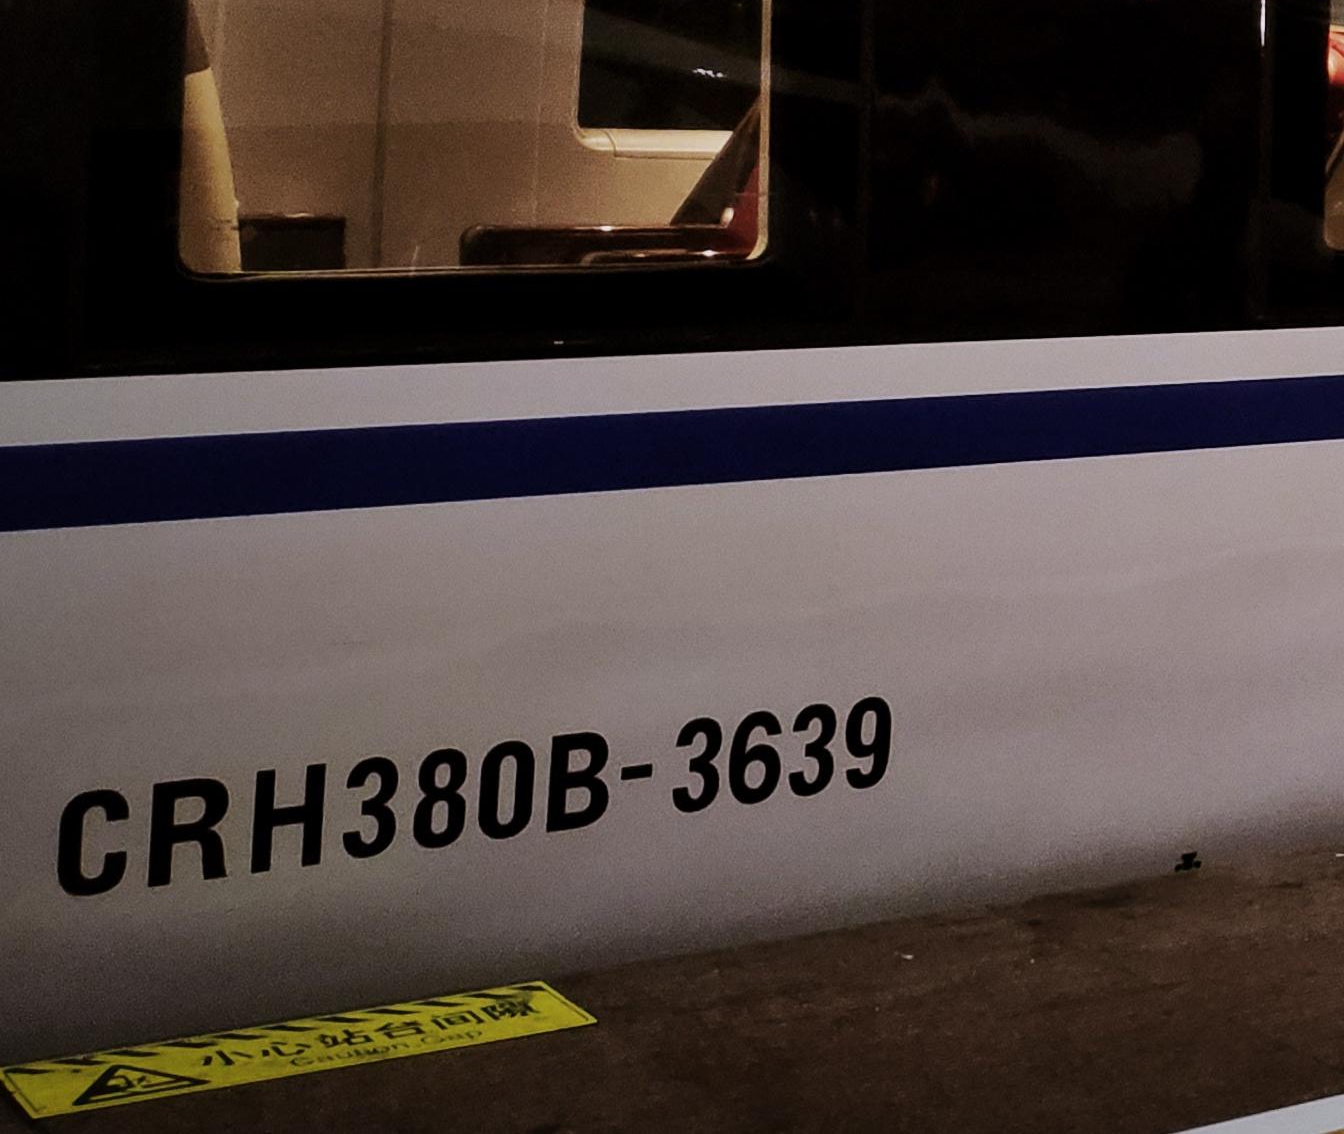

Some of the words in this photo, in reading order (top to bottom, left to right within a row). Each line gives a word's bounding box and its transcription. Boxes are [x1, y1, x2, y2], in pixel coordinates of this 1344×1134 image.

[57, 696, 892, 897] CRH380B-3639
[203, 999, 540, 1066] 小心站台间隙
